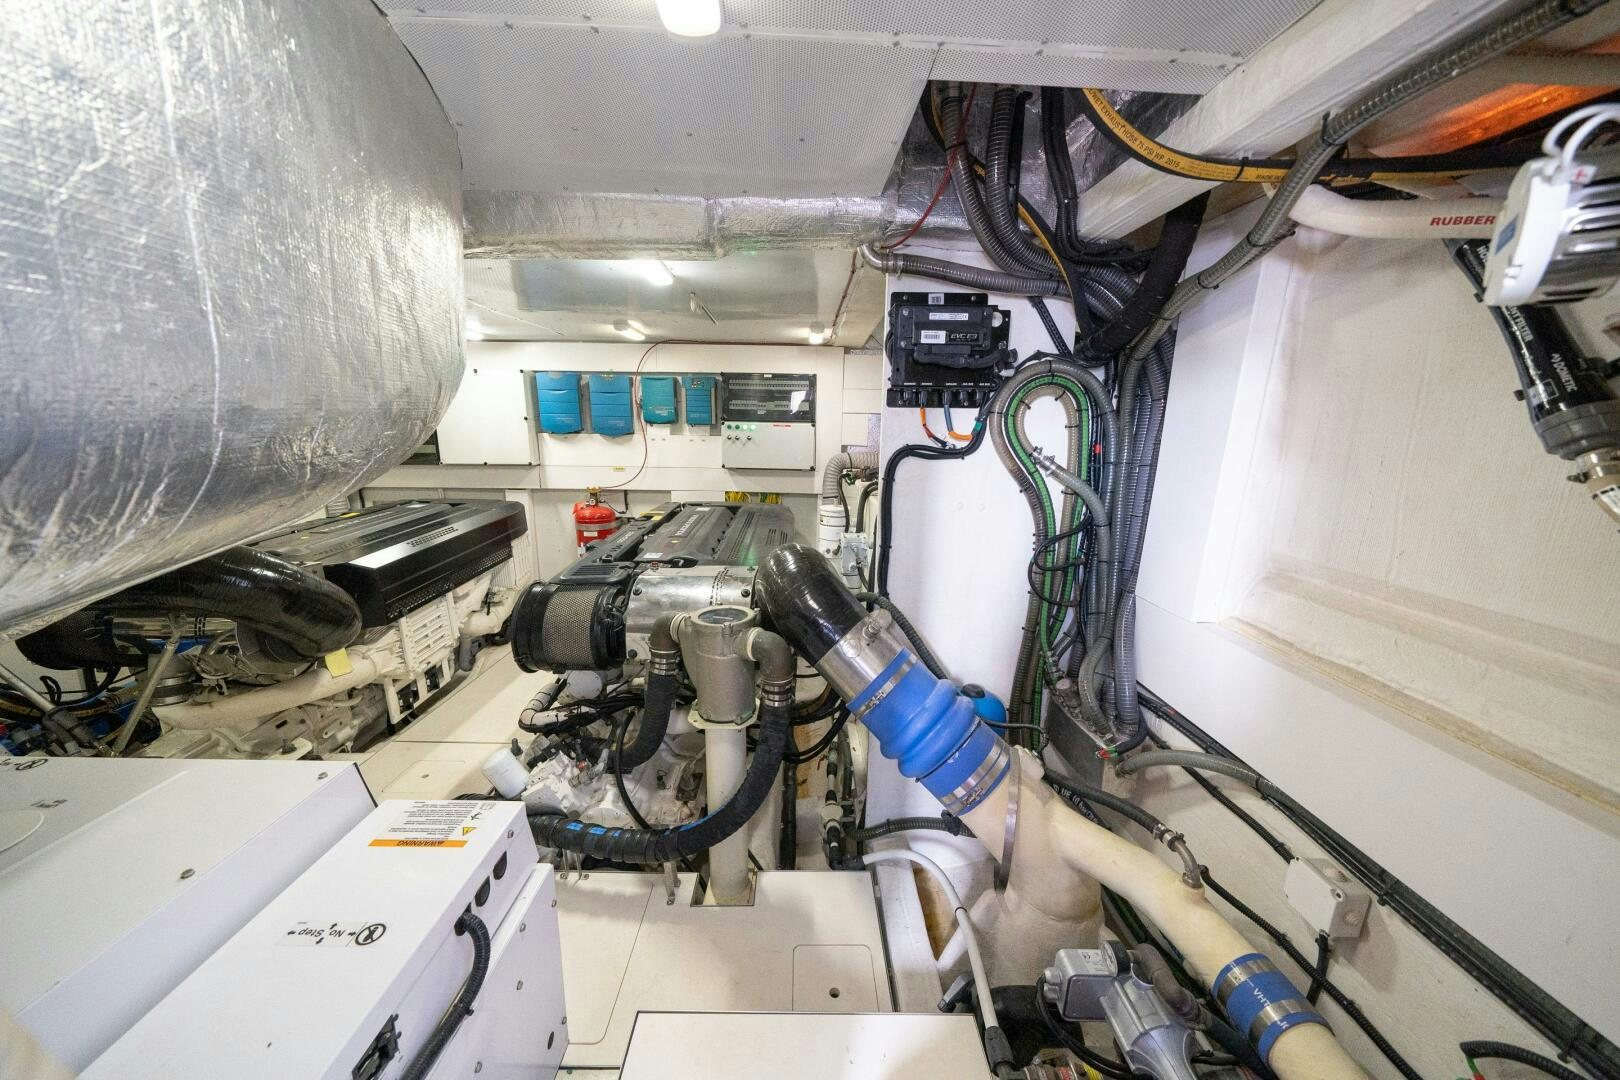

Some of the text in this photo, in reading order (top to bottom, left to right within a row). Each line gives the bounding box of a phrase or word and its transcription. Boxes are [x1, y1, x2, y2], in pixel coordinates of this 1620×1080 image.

[1101, 104, 1126, 130] EXHAUST
[1122, 128, 1138, 143] HOSE
[1430, 215, 1497, 226] RUBBER
[1516, 316, 1534, 342] FILTER
[1553, 360, 1578, 393] DOMETIC
[298, 927, 346, 938] No Step
